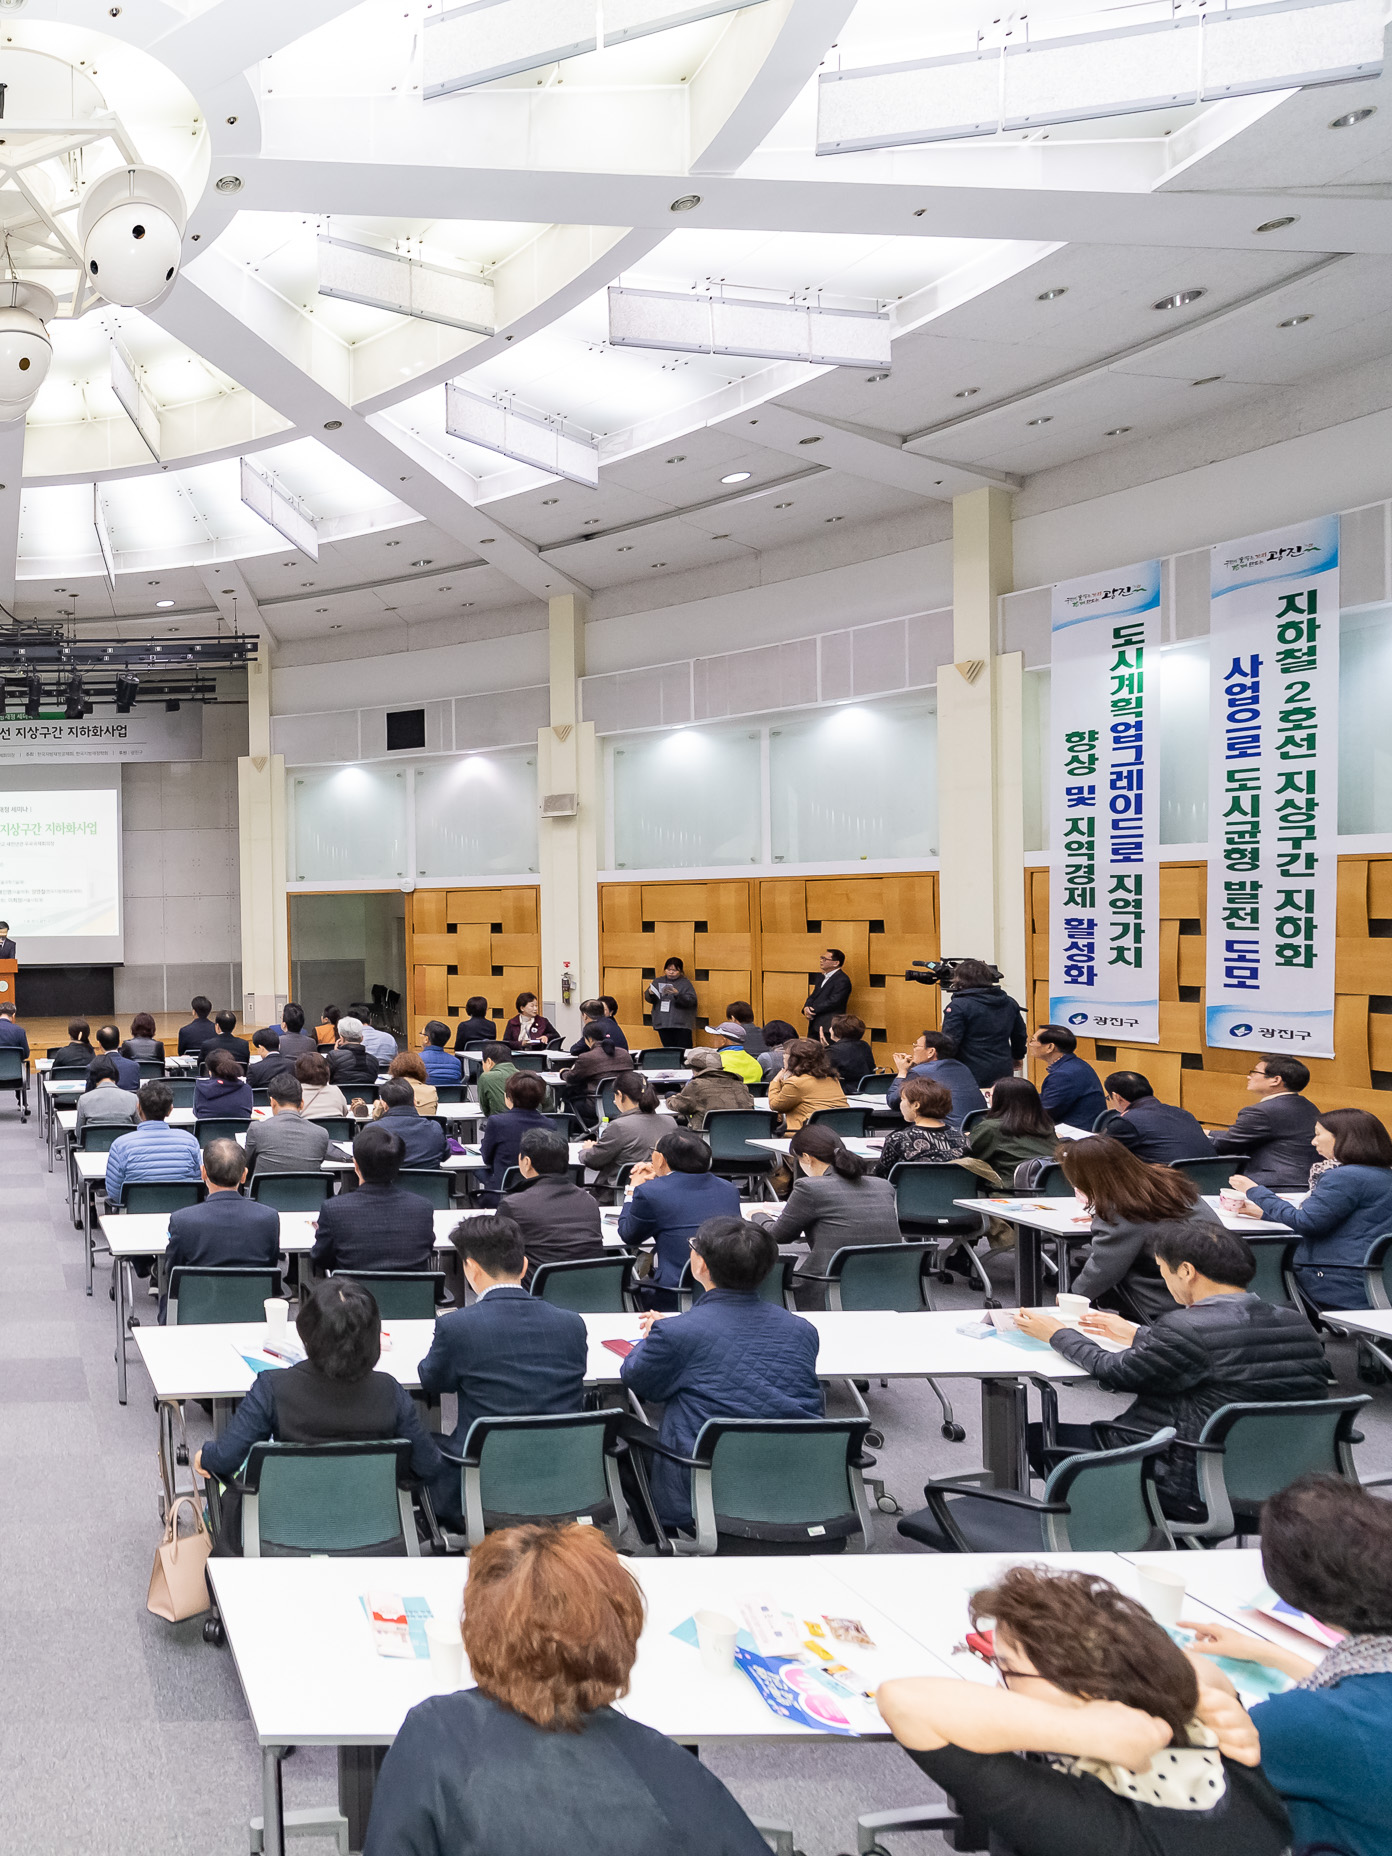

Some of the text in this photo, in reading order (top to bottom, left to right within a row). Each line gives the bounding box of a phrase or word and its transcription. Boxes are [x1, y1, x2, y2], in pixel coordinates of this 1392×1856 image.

[1266, 545, 1305, 562] 광진
[1101, 586, 1133, 600] 광진
[15, 725, 63, 740] 지상구간
[67, 724, 128, 738] 지하화사업
[1273, 588, 1322, 969] 지하철 2호선 지상구간 지하화
[0, 822, 42, 836] 지상구간
[45, 821, 97, 836] 지하화사업
[1221, 653, 1264, 990] 사업으로 도시균형 발전 도모
[1063, 729, 1099, 987] 향상 및 지역경제 활성화
[1108, 873, 1145, 969] 지역가치
[1093, 1015, 1140, 1028] 광진구
[1258, 1027, 1312, 1041] 광진구
